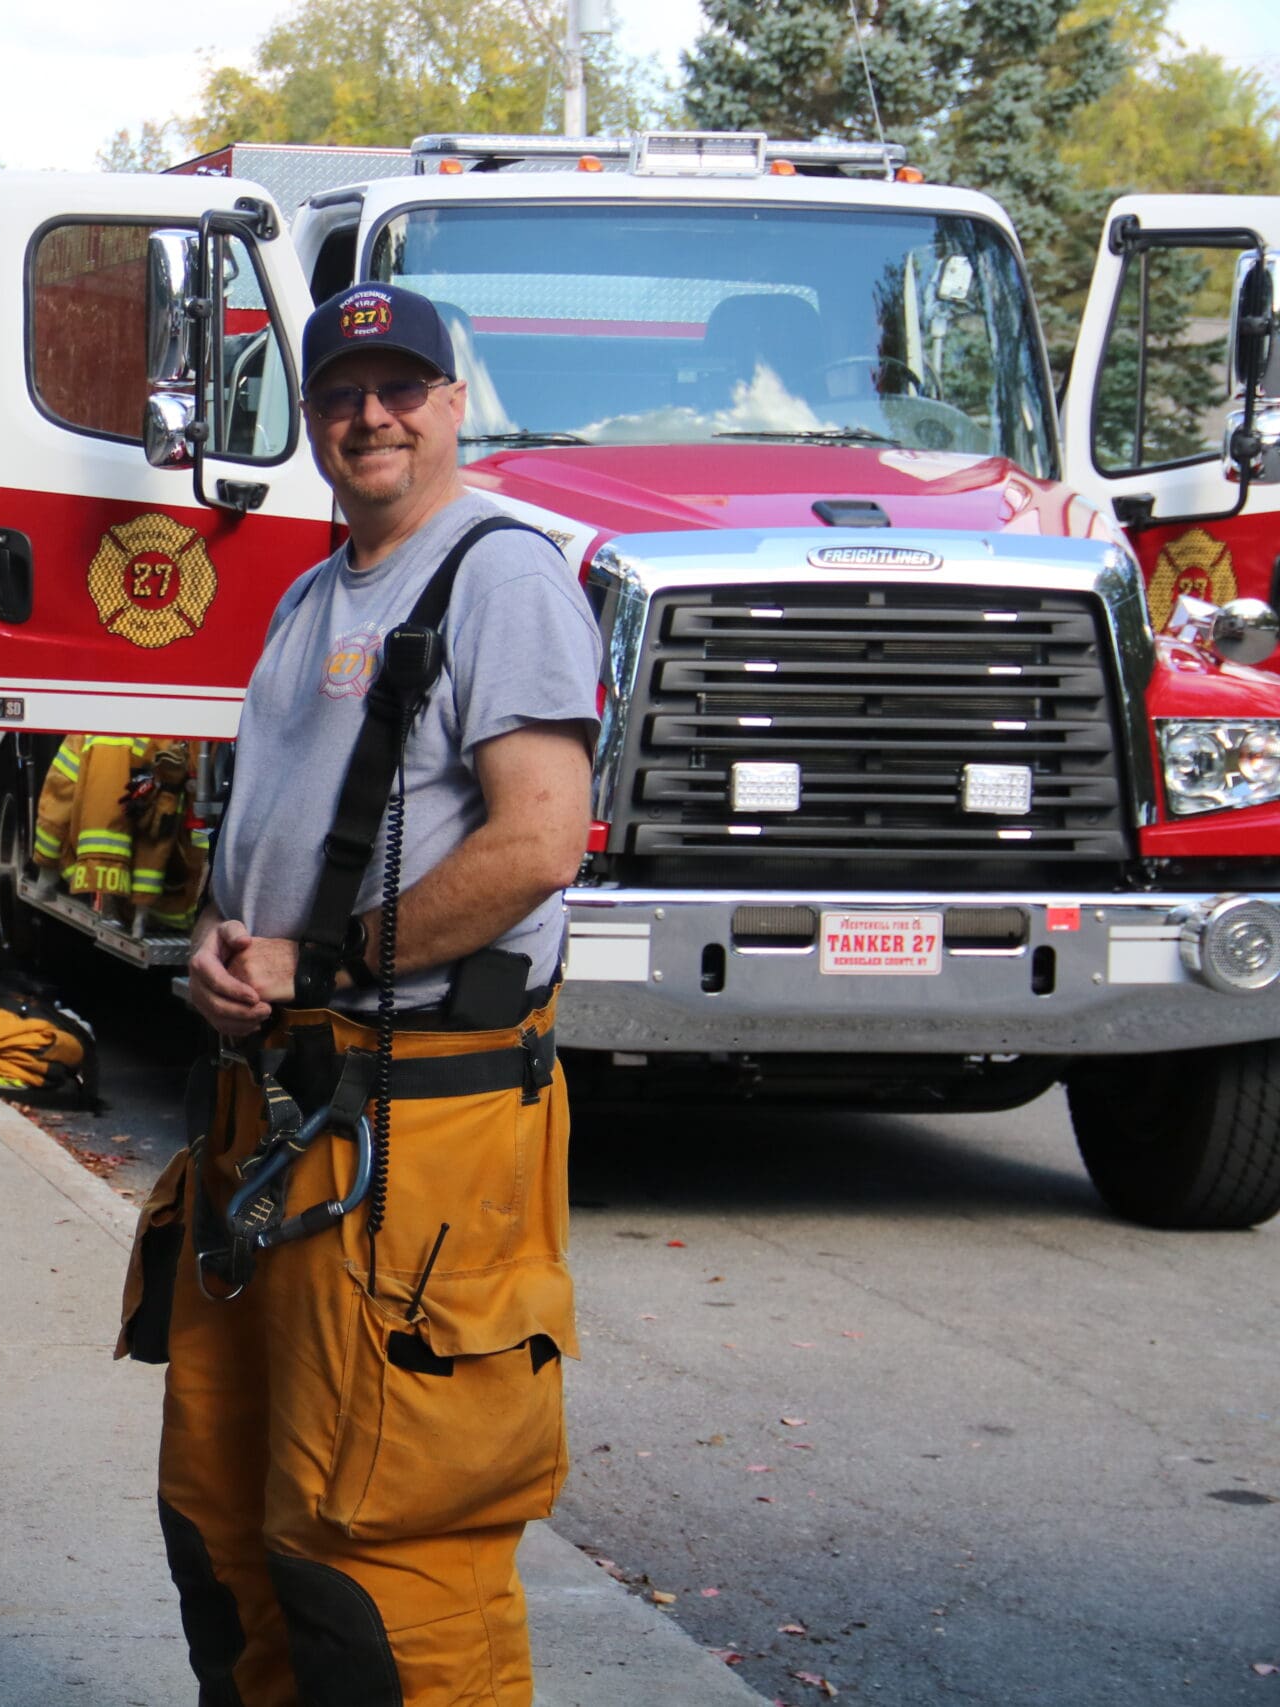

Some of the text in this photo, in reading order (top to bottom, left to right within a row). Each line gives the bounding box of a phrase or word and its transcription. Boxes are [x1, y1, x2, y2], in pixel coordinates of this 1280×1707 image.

[354, 310, 377, 324] 27
[823, 549, 930, 565] FREIGHTLINER
[133, 563, 173, 597] 27
[329, 653, 360, 674] 27
[6, 701, 22, 716] SD
[74, 866, 89, 889] B.
[827, 934, 937, 953] TANKER 27
